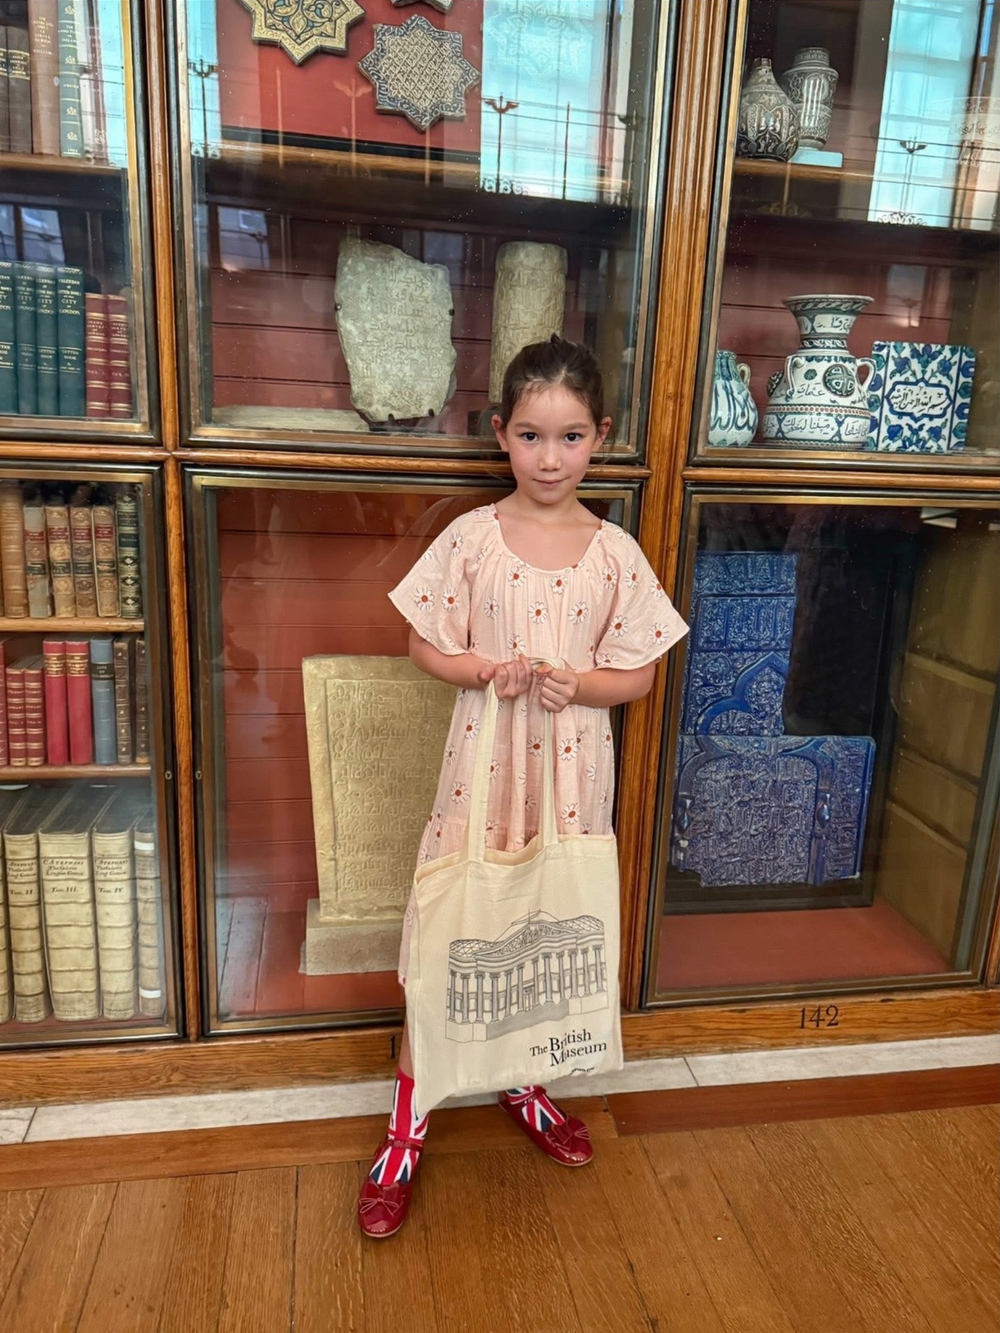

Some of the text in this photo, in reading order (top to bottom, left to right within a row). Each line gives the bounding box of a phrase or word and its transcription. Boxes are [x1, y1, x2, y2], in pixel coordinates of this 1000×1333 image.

[800, 1004, 839, 1029] 142
[530, 1028, 592, 1057] The British
[550, 1042, 607, 1067] Museum
